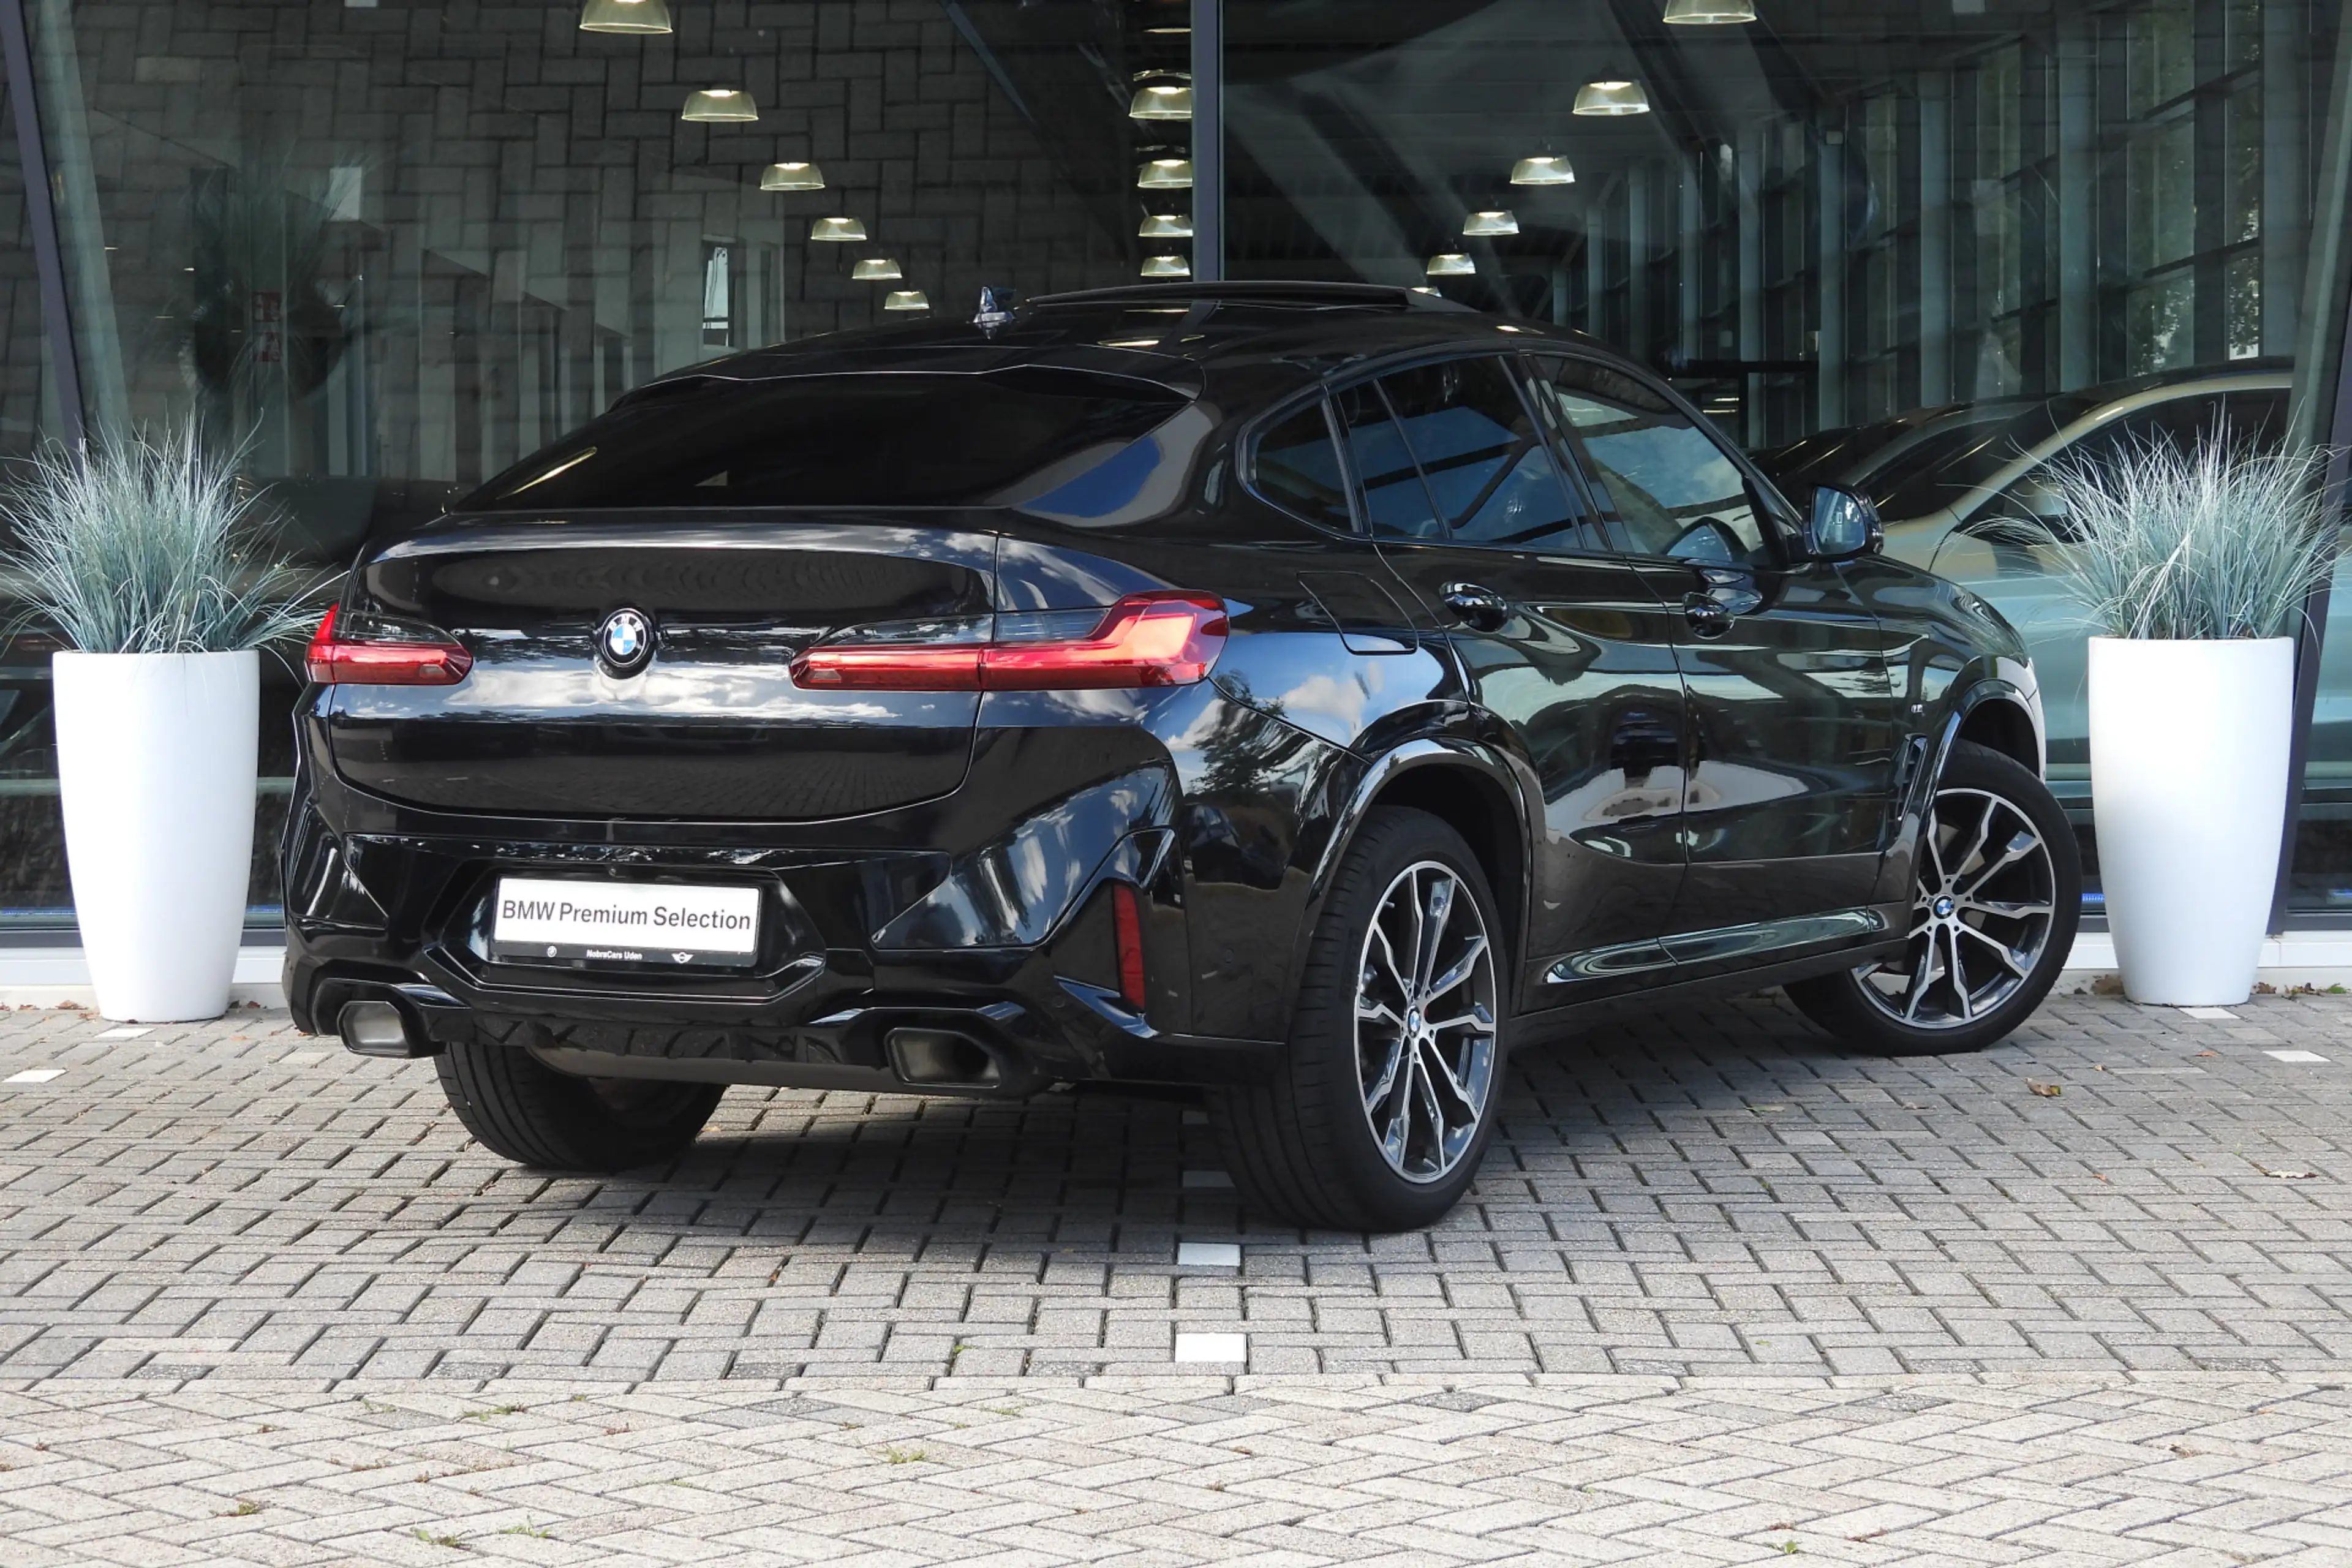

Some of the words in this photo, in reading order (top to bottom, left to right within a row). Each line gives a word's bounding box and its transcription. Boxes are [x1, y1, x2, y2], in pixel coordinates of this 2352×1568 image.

[502, 900, 556, 921] BMW
[559, 902, 648, 925] Premium
[653, 906, 750, 930] Selection
[624, 950, 643, 960] Uden
